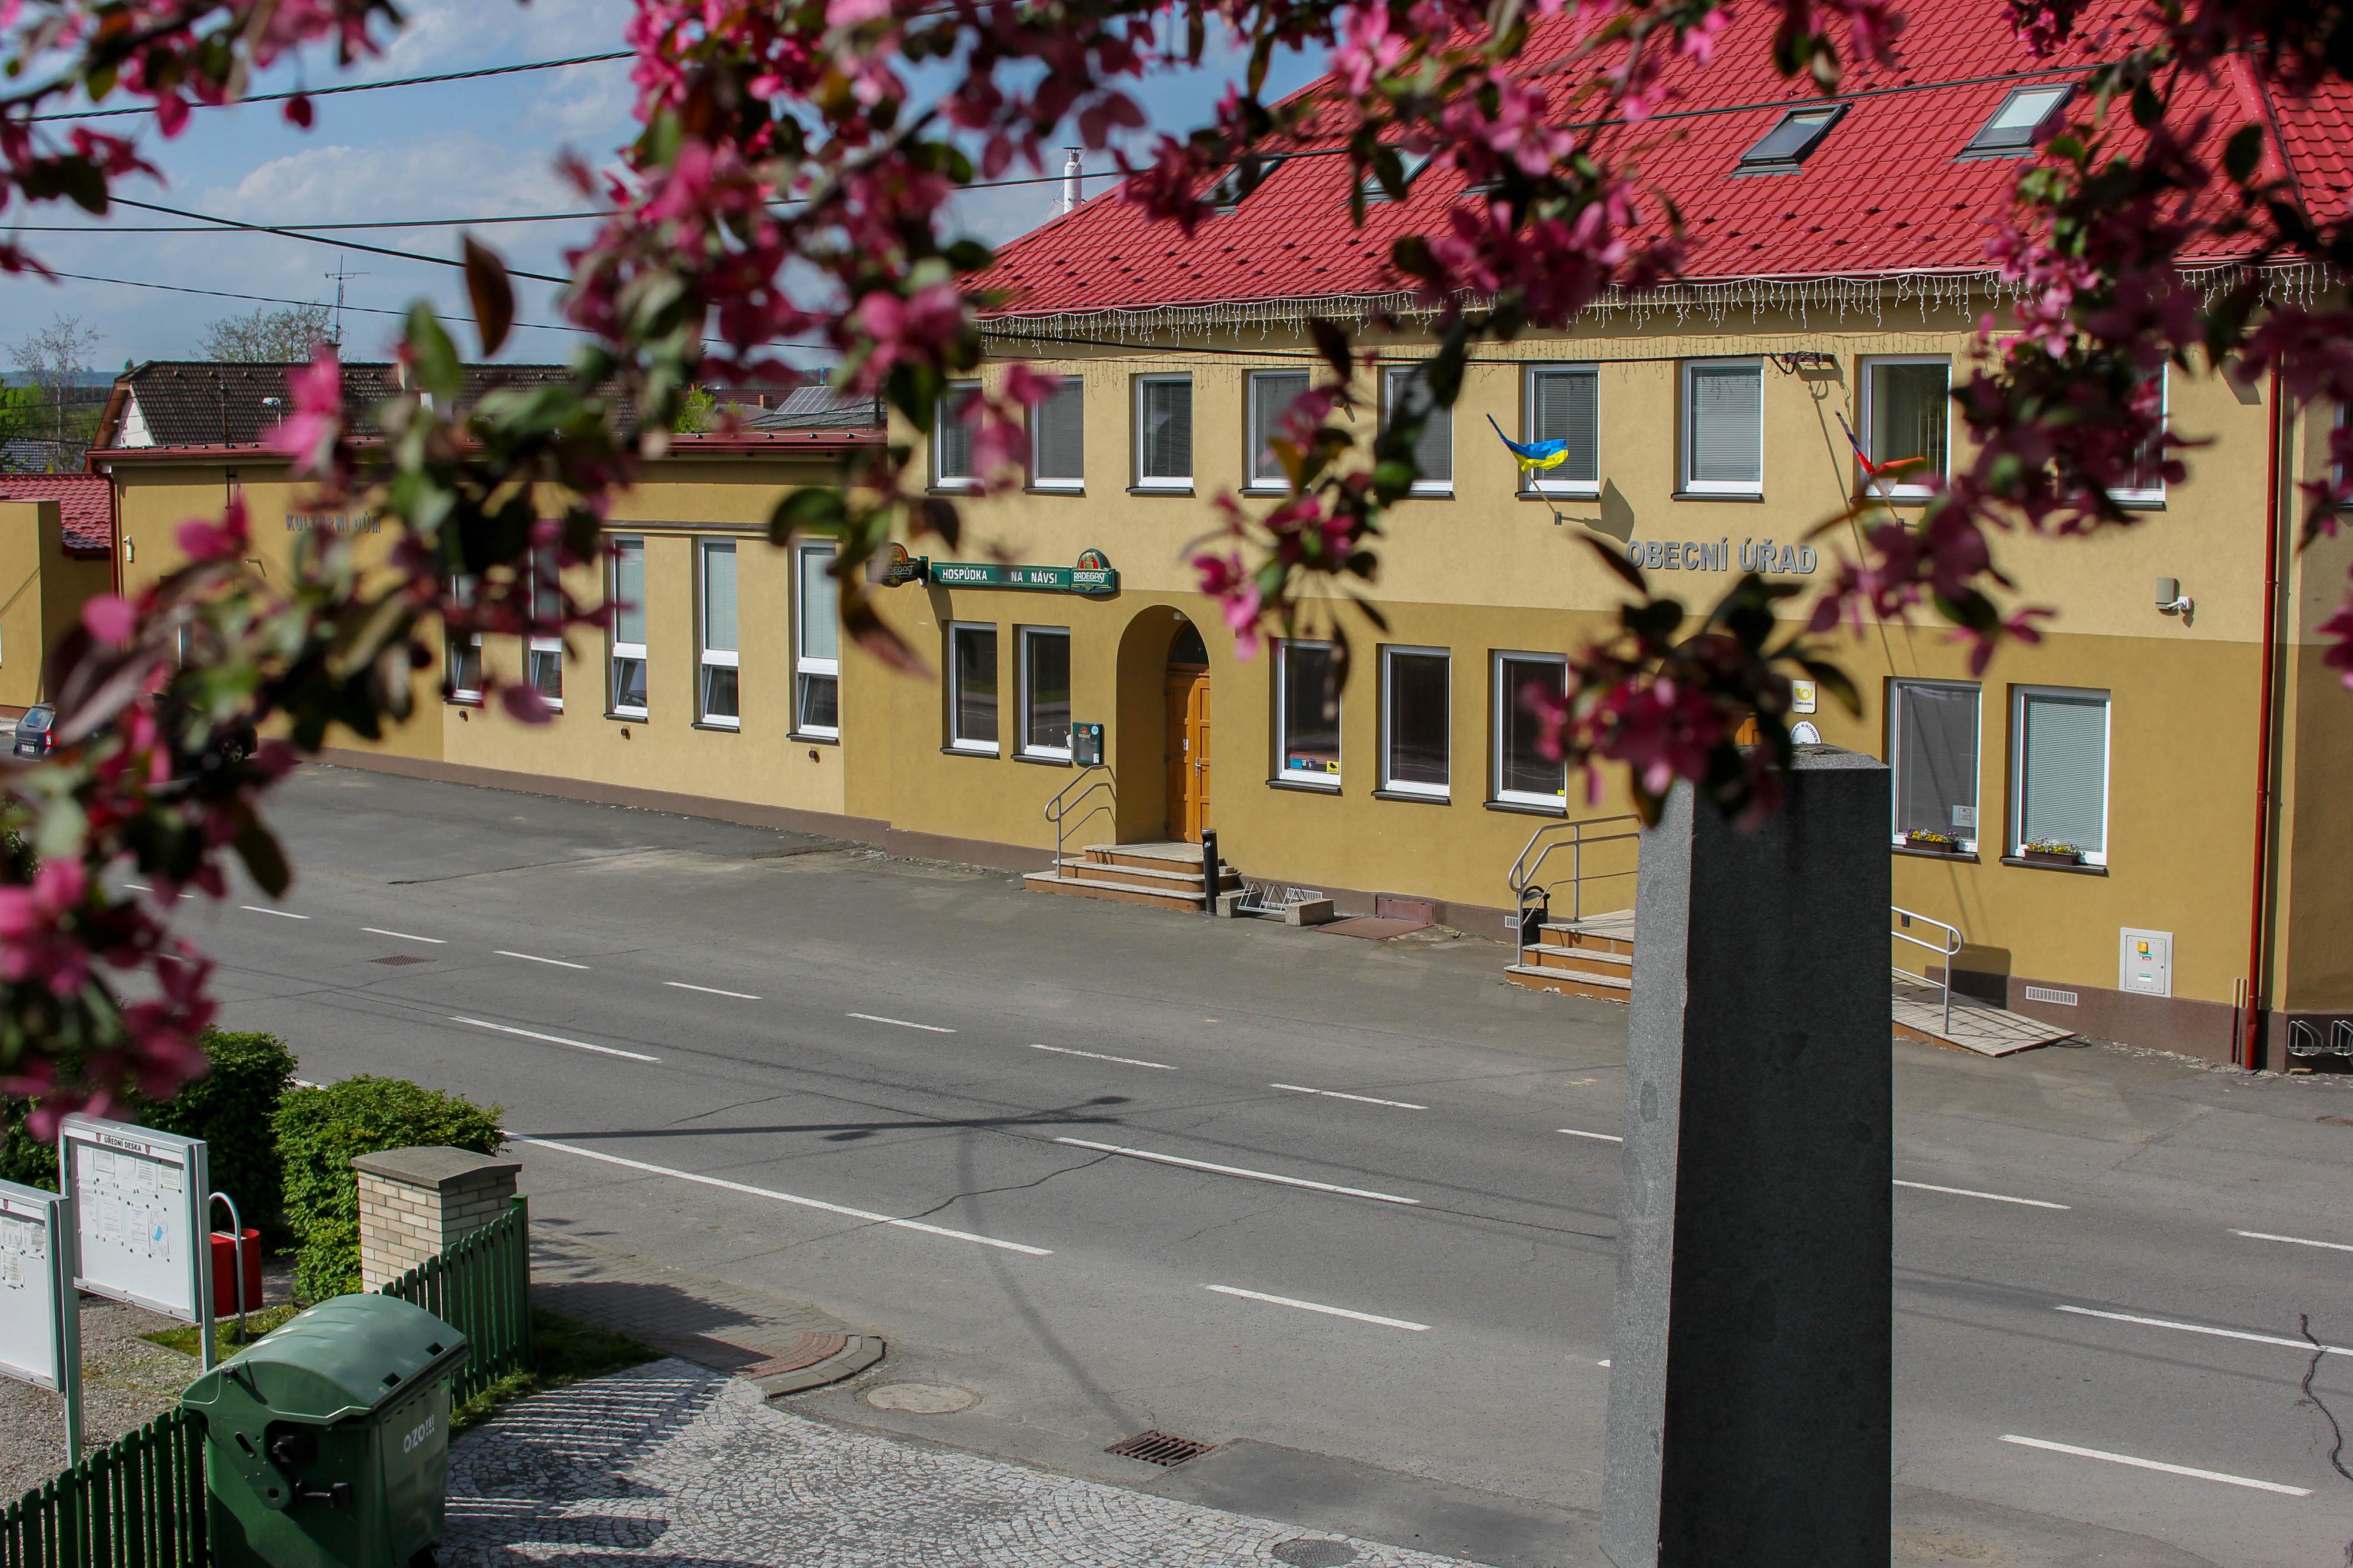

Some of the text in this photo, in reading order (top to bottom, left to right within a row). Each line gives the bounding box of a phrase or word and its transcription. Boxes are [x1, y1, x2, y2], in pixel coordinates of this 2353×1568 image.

[353, 510, 381, 534] DŮM
[1626, 537, 1817, 574] OBECNÍ ÚŘAD
[882, 565, 914, 575] DEGAST
[942, 567, 1058, 584] HOSPŮDKA NA NÁVSI
[1074, 572, 1106, 583] RADEGAST
[1801, 723, 1819, 742] KNIHOVN
[104, 1135, 142, 1152] ÚŘEDNÍ DESKA
[404, 1414, 435, 1453] OZO!!!
